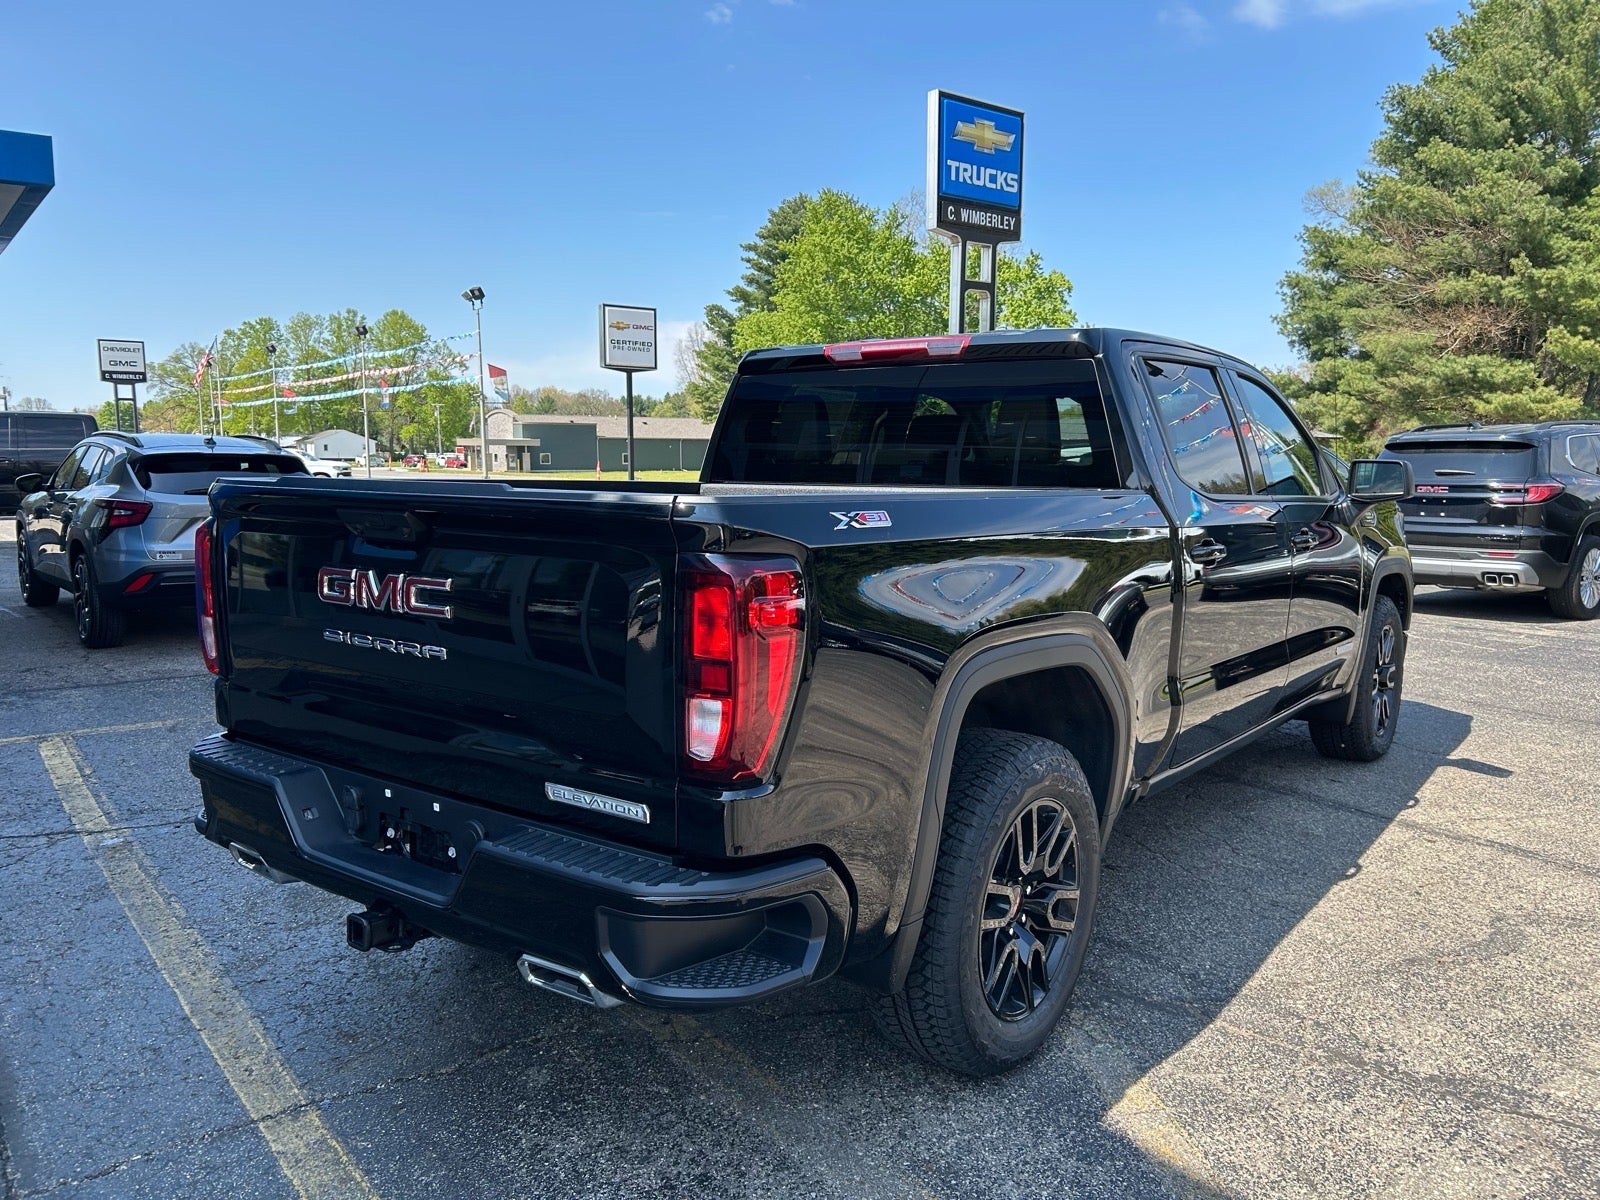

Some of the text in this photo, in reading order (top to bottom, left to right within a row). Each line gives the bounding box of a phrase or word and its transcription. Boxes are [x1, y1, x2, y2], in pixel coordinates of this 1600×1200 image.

[947, 159, 1018, 193] TRUCKS
[947, 206, 1016, 231] C. WIMBERLEY
[610, 338, 653, 348] CERTIFIED
[1416, 485, 1449, 493] GMC
[317, 566, 453, 620] GMC
[322, 628, 448, 661] SIERRA
[552, 789, 640, 817] ELEVATION
